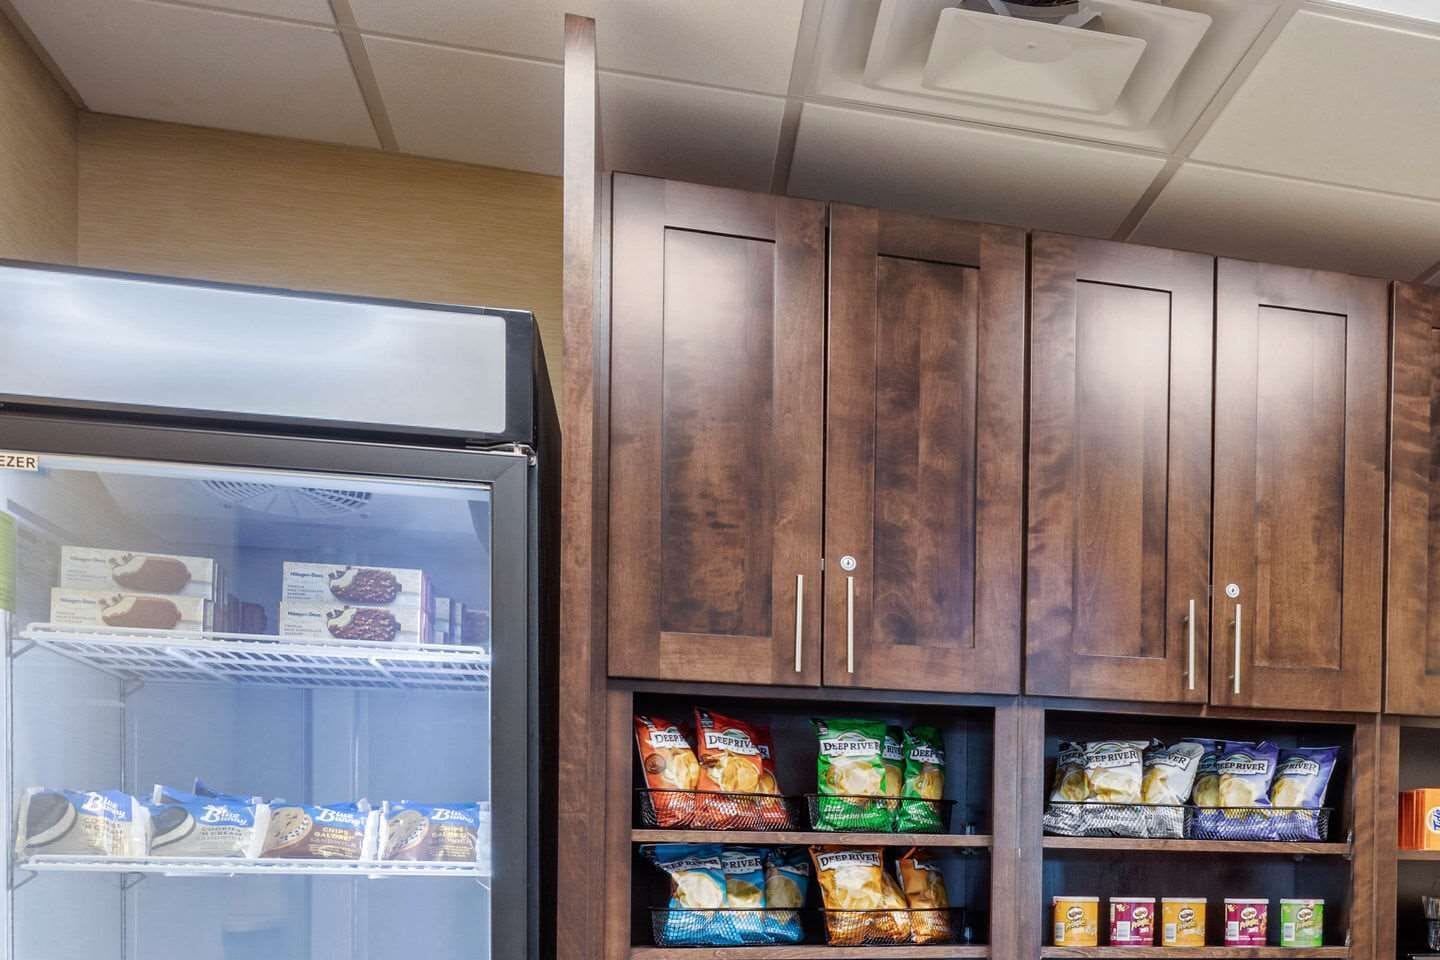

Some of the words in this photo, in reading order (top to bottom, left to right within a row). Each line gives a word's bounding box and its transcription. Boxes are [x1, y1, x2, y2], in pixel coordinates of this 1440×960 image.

[0, 455, 36, 468] EZER
[655, 734, 679, 743] DEEP
[709, 735, 735, 746] DEEP
[823, 742, 849, 751] DEEP
[849, 741, 880, 750] RIVER
[1107, 751, 1137, 762] RIVER
[1169, 754, 1187, 764] VER
[1236, 763, 1266, 771] RIVER
[728, 859, 762, 869] RIVER
[821, 855, 848, 866] DEEP
[848, 853, 879, 862] RIVER
